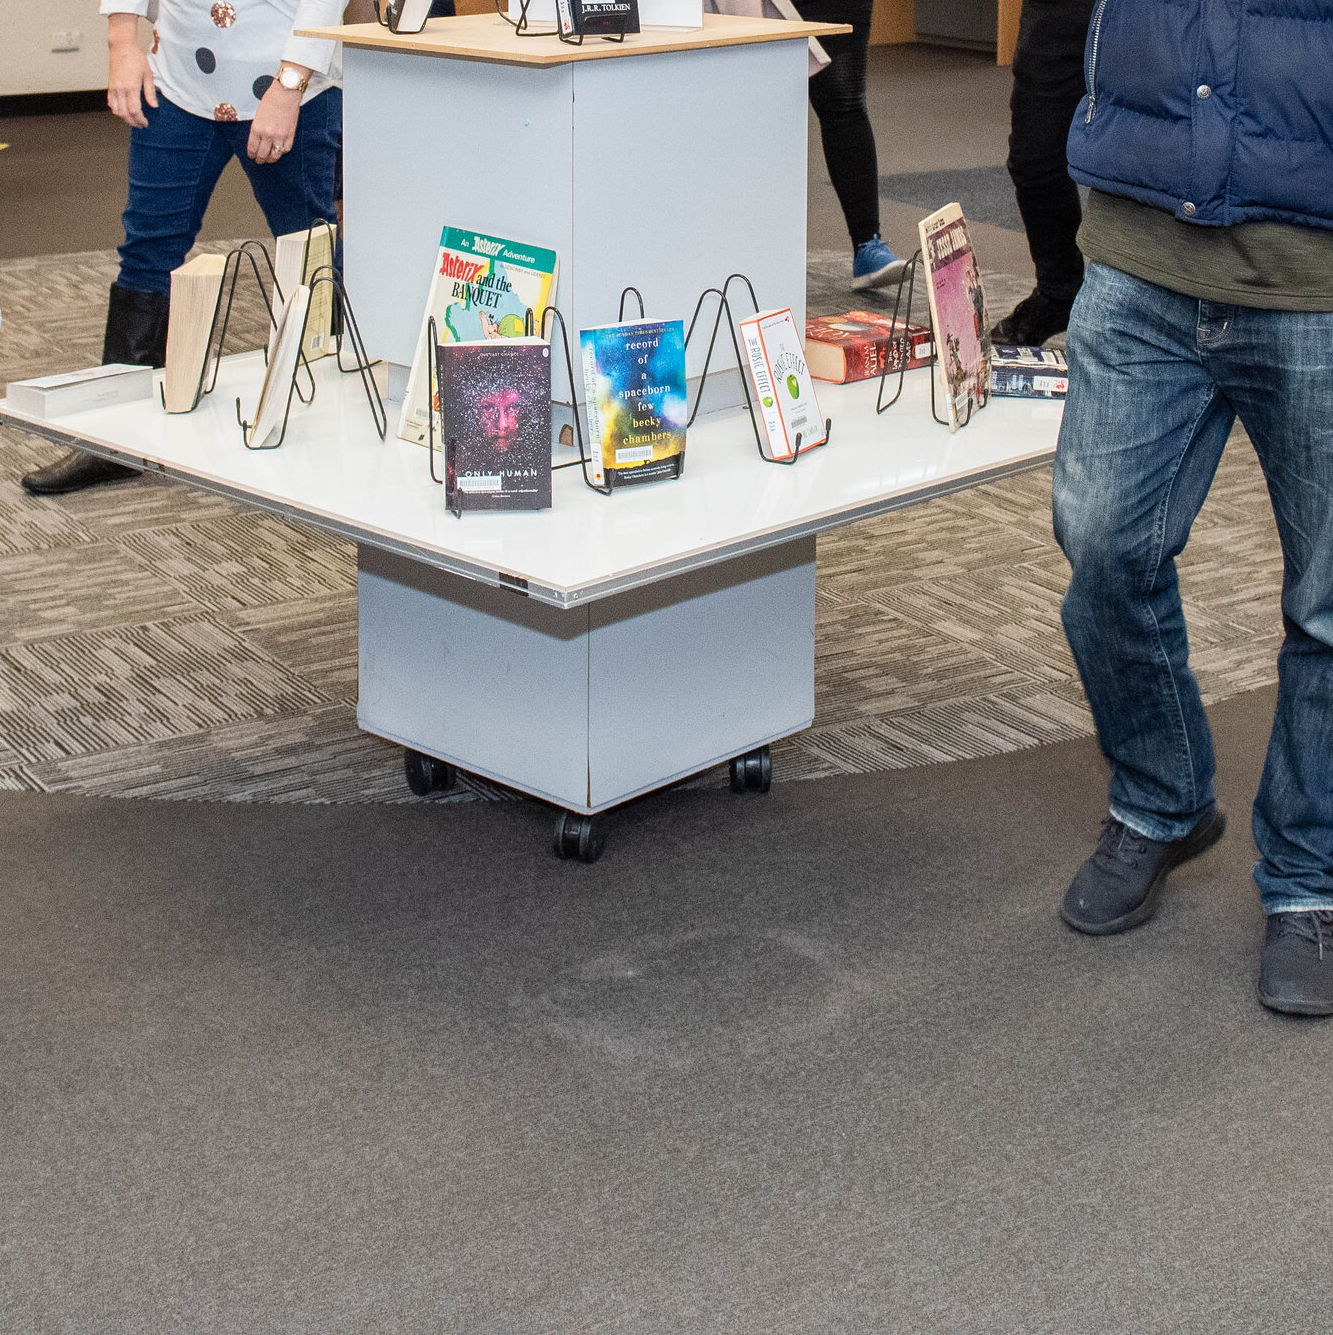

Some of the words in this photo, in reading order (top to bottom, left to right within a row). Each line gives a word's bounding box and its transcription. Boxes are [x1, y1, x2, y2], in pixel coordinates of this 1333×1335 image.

[603, 3, 631, 12] TOLKIEN
[460, 238, 469, 247] An
[472, 236, 506, 257] Asterix
[503, 249, 535, 264] Adventure
[439, 252, 485, 283] Asterix
[475, 273, 496, 288] and
[495, 275, 512, 292] the
[451, 281, 502, 309] BANQUET
[625, 337, 658, 351] record
[748, 338, 758, 346] THE
[637, 355, 648, 364] of
[750, 347, 764, 369] ROSIE
[869, 342, 878, 375] AUEL
[756, 370, 771, 393] EFFECT
[618, 385, 671, 399] spaceborn
[637, 401, 654, 412] few
[633, 416, 661, 428] becky
[622, 431, 671, 445] chambers
[499, 468, 538, 477] HUMAN
